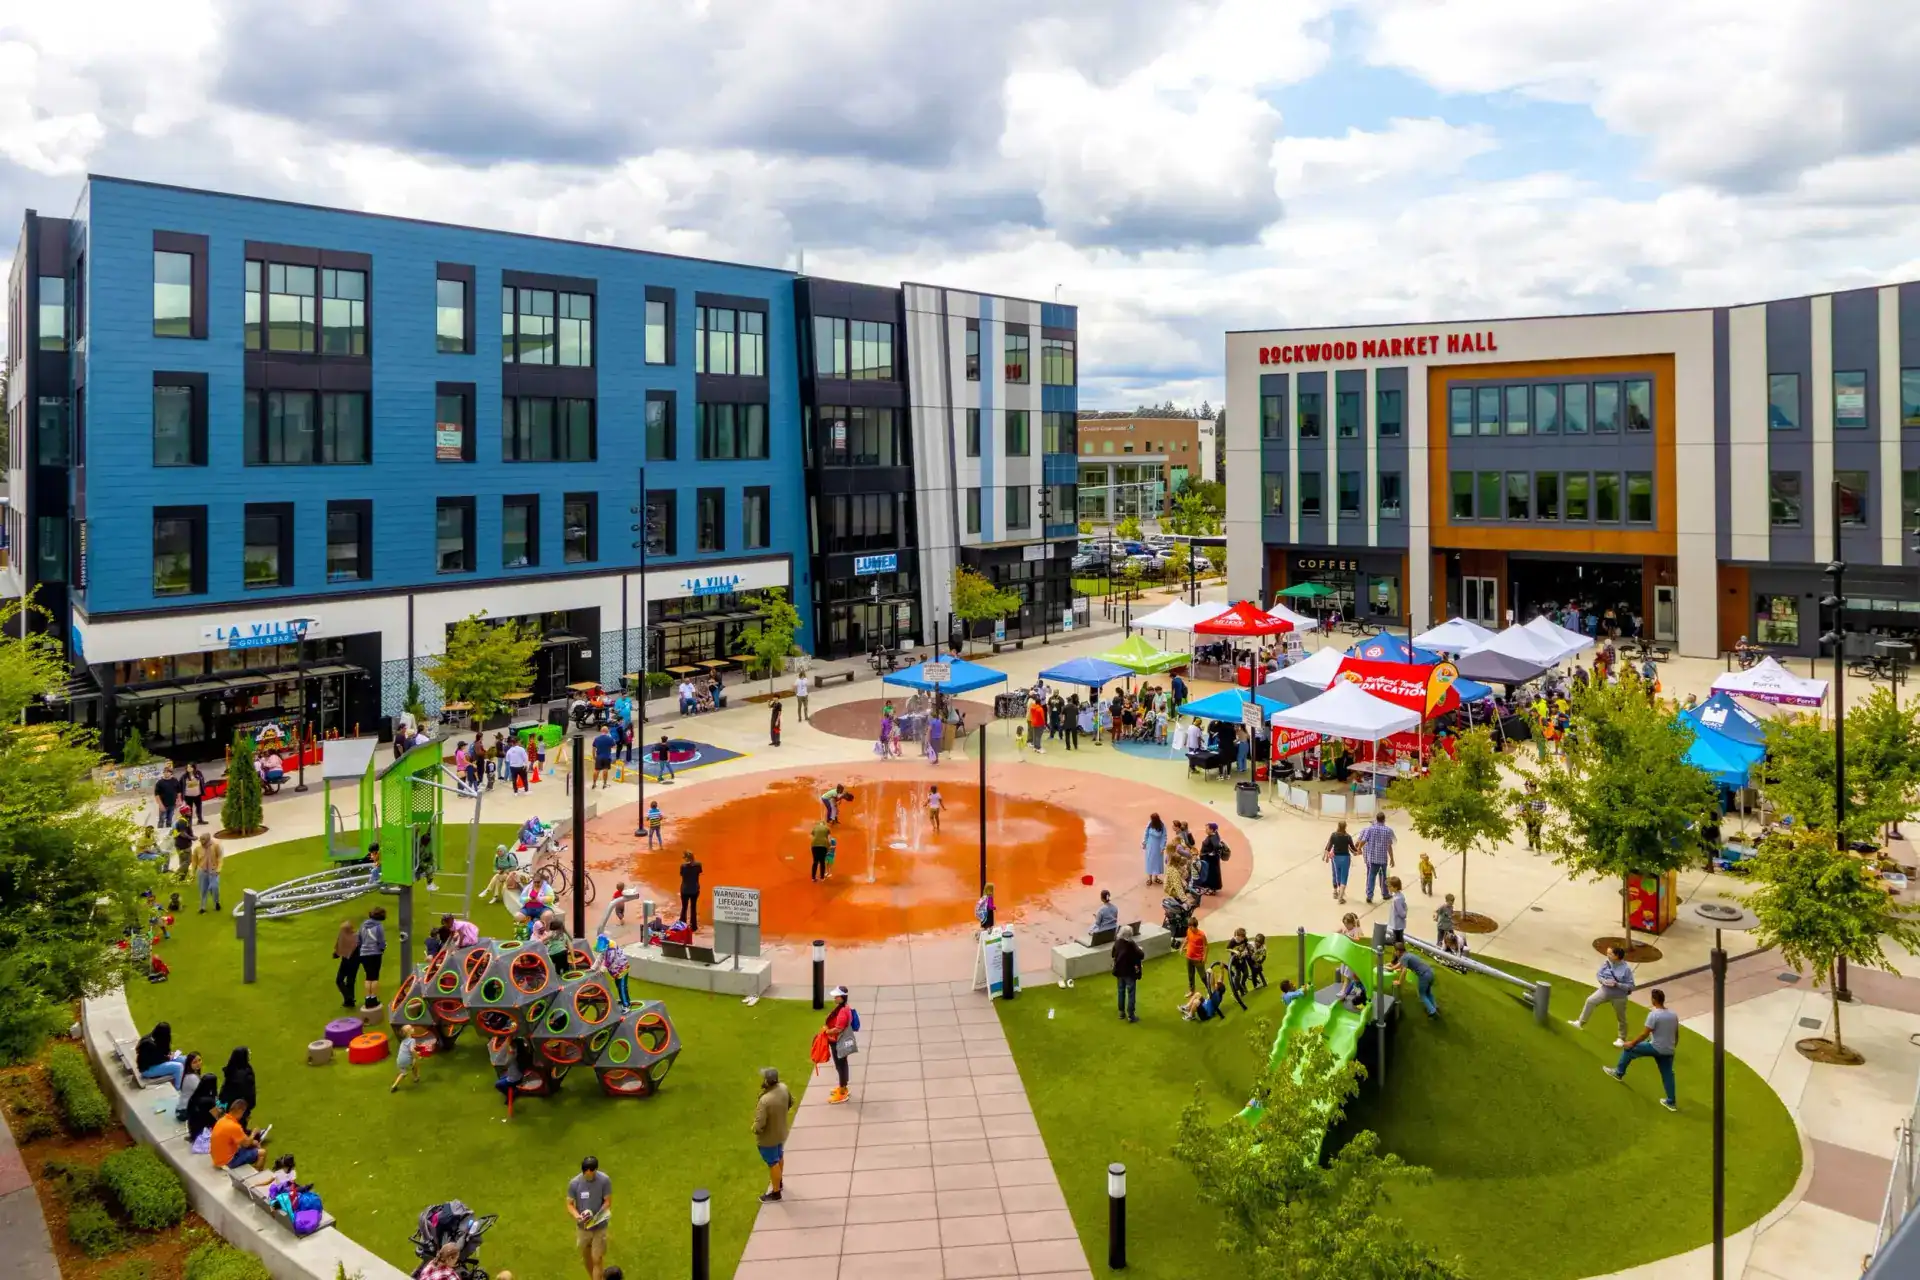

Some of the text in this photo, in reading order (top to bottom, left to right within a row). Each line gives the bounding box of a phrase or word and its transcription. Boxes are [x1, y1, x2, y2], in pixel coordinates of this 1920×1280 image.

[1259, 331, 1498, 364] ROCKWOOD MARKET HALL
[856, 555, 897, 570] LUMEN
[1298, 559, 1357, 570] COFFEE
[687, 574, 739, 589] LA VILLA
[217, 626, 240, 640] LA
[239, 638, 264, 647] GRILL
[272, 635, 289, 643] BAR
[1361, 682, 1427, 697] DAYCATION
[713, 890, 747, 899] WARNING:
[718, 899, 753, 907] LIFEGUARD
